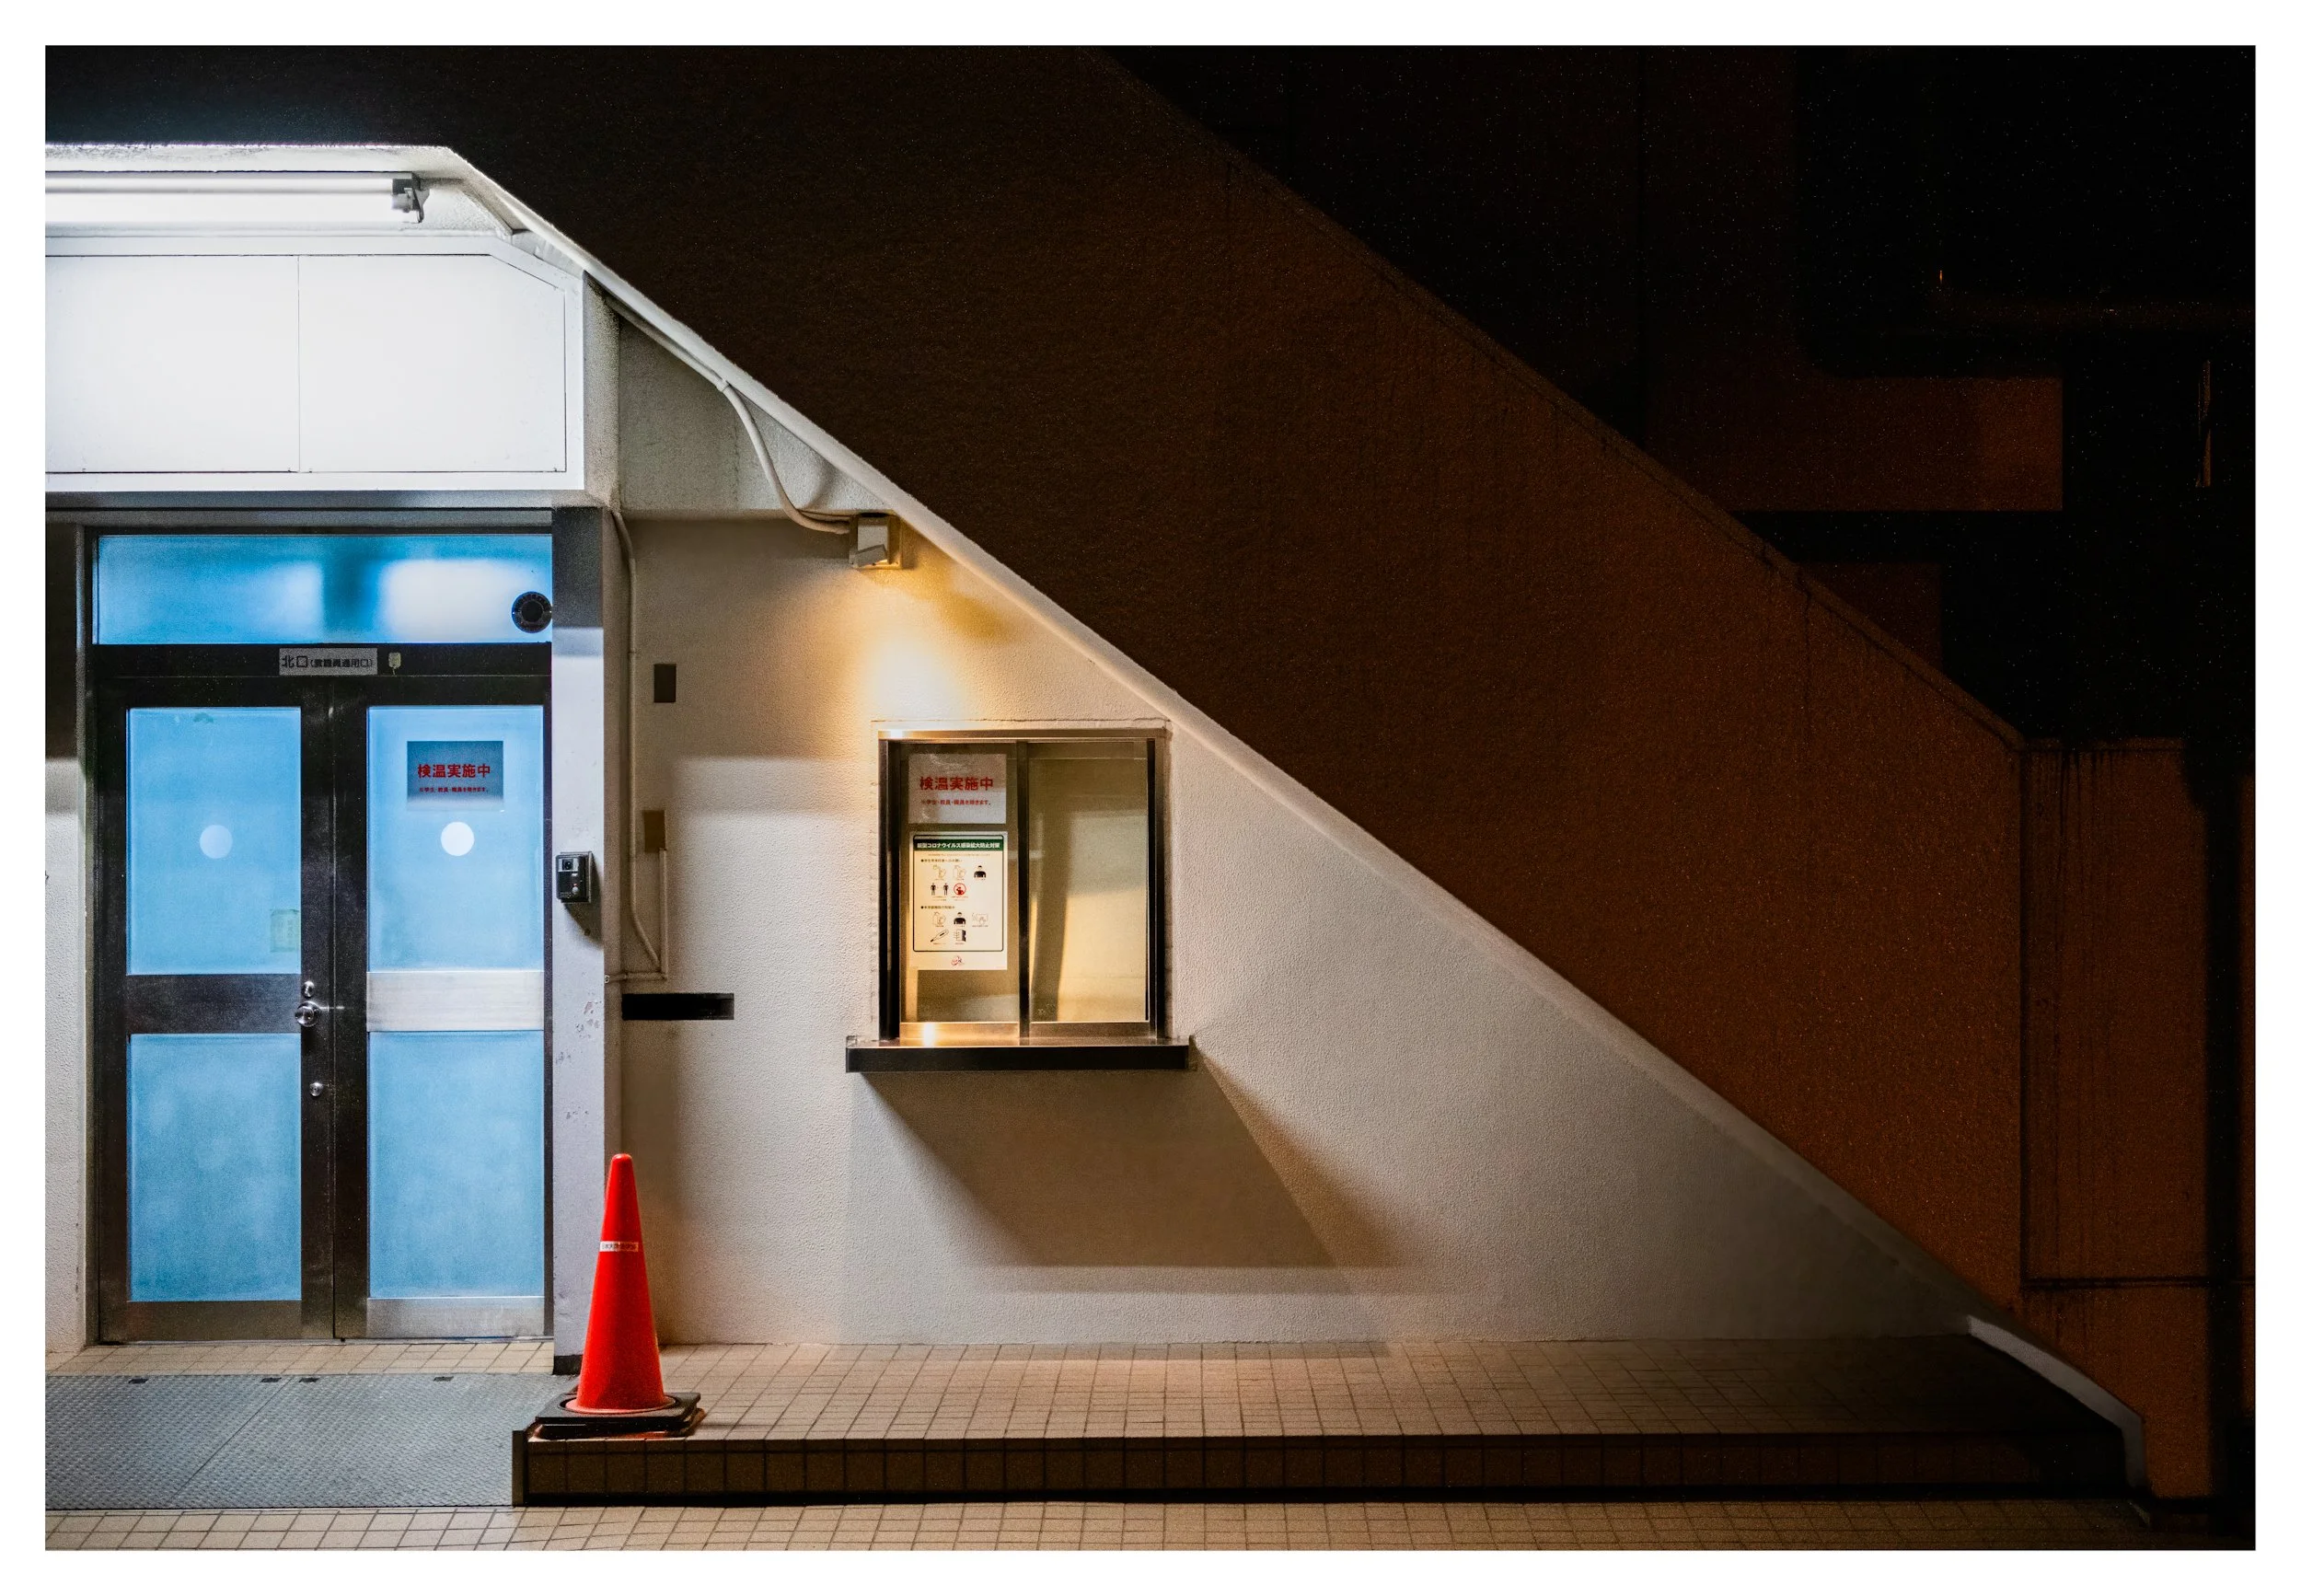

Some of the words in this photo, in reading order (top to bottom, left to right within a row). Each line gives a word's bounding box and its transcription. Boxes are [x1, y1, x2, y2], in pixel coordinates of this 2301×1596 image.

[417, 763, 491, 779] 検温実施中
[919, 776, 993, 791] 検温実施中
